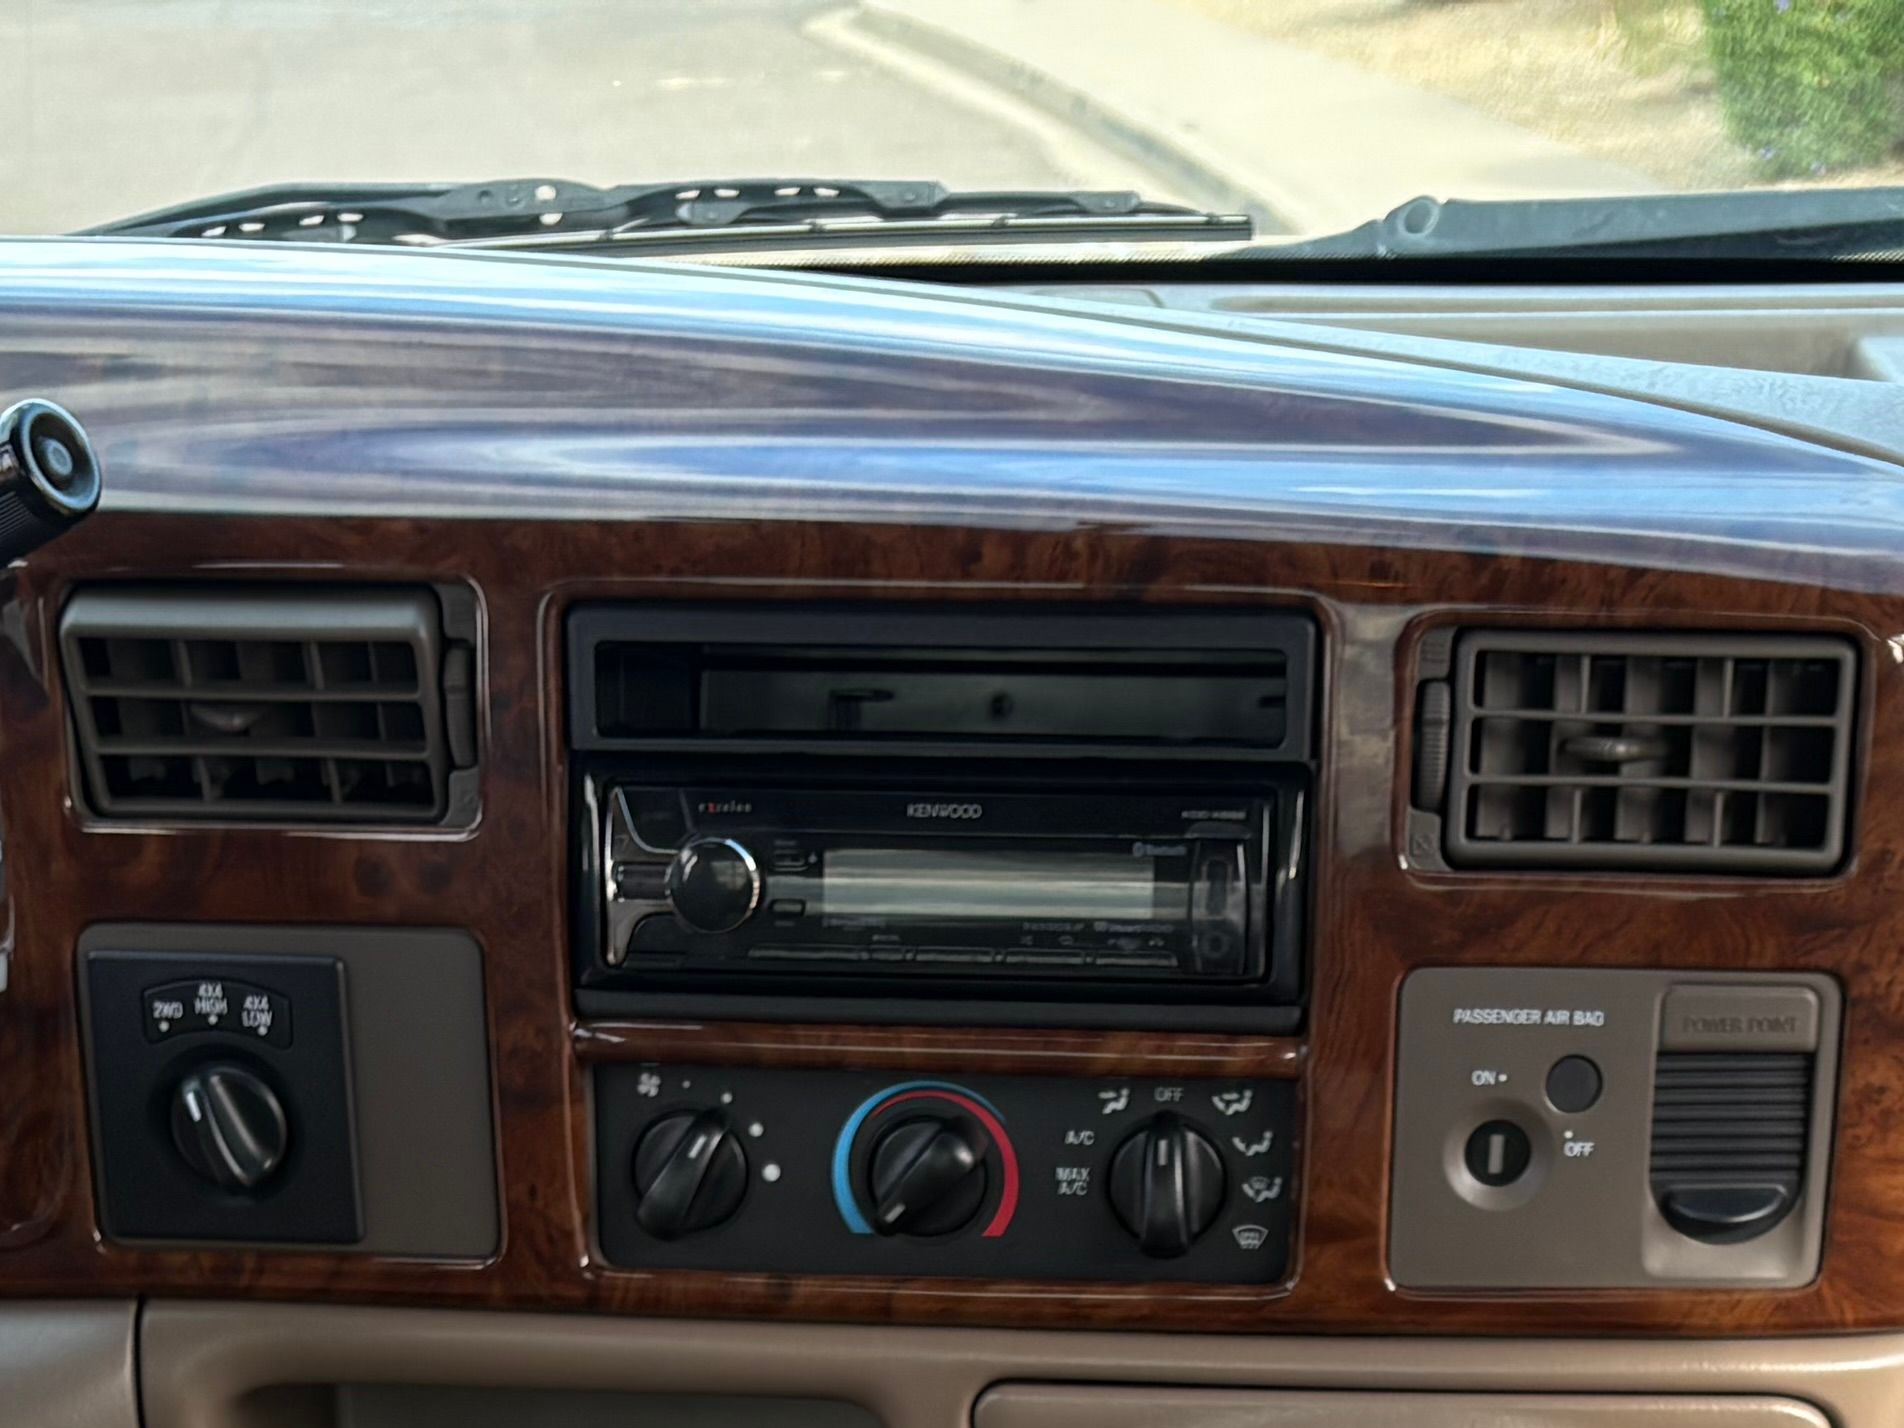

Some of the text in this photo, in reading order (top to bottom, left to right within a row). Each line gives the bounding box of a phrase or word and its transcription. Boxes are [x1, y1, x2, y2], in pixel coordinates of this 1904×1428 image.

[907, 804, 983, 819] KENWOOD
[1453, 1008, 1604, 1027] PASSENGER AIR BAG
[1682, 1016, 1799, 1033] POWER POINT
[1471, 1070, 1496, 1086] ON
[1154, 1087, 1183, 1102] OFF
[1065, 1130, 1095, 1146] A/C
[1564, 1141, 1594, 1157] OFF
[1056, 1167, 1090, 1182] MAX
[1057, 1180, 1088, 1195] A/C
